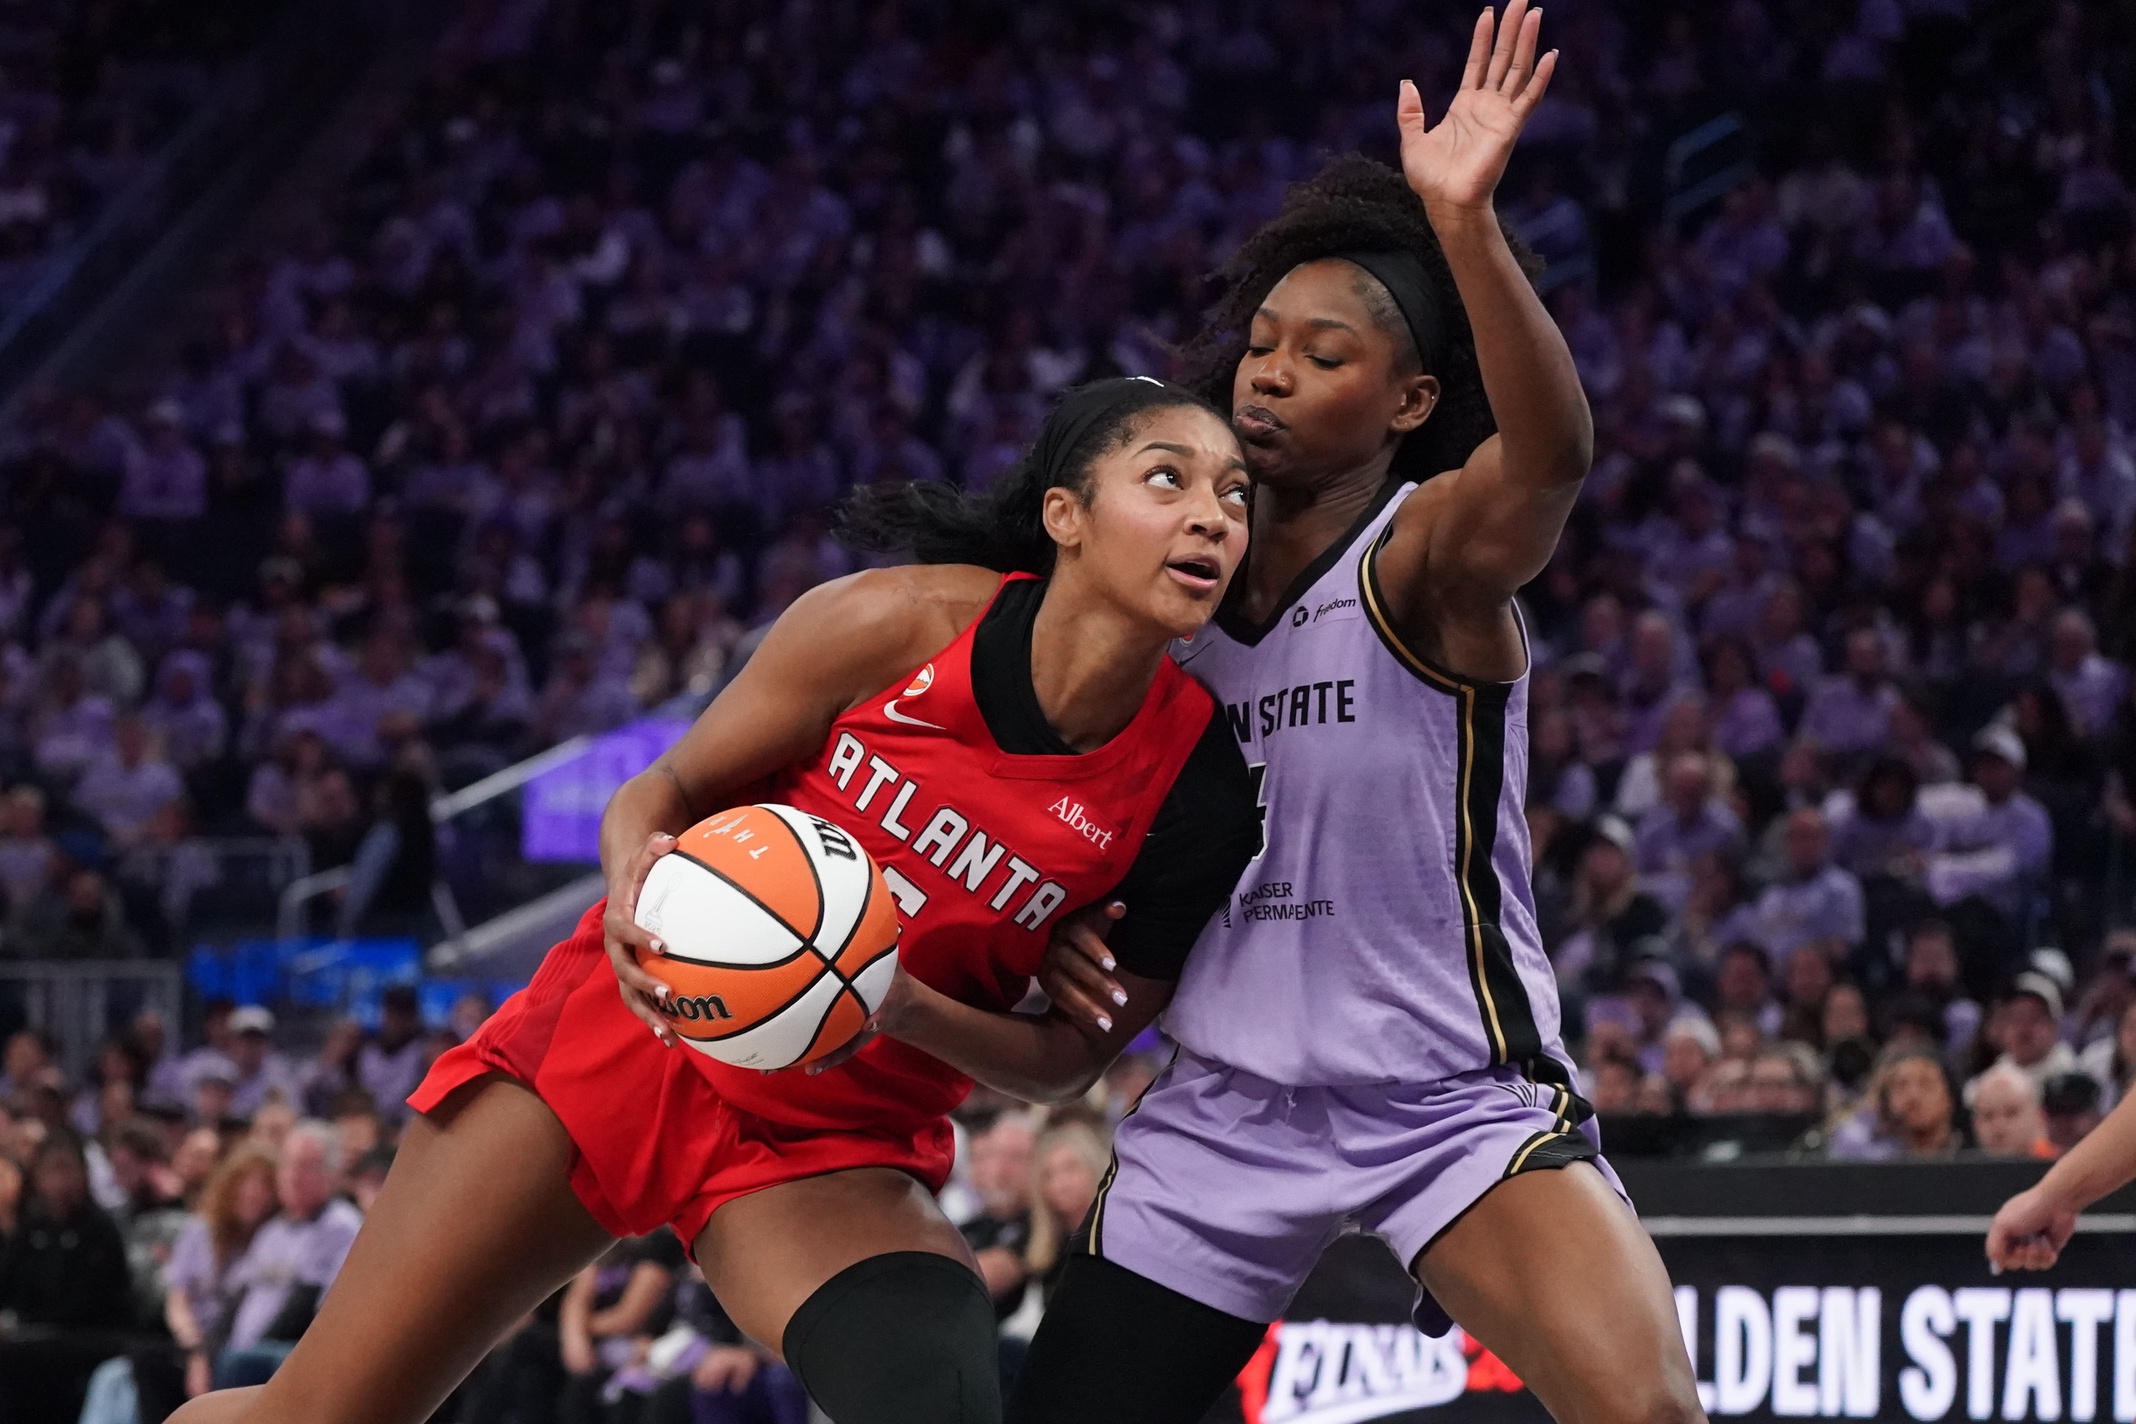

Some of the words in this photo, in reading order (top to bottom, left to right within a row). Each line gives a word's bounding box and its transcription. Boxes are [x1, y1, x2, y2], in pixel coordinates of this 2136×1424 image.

[1259, 679, 1356, 738] STATE
[828, 731, 1067, 932] ATLANTA
[1048, 796, 1112, 849] Albert
[1239, 882, 1294, 907] KAISER
[1243, 900, 1335, 923] PERMAENTE
[1674, 1285, 1882, 1417] LDEN
